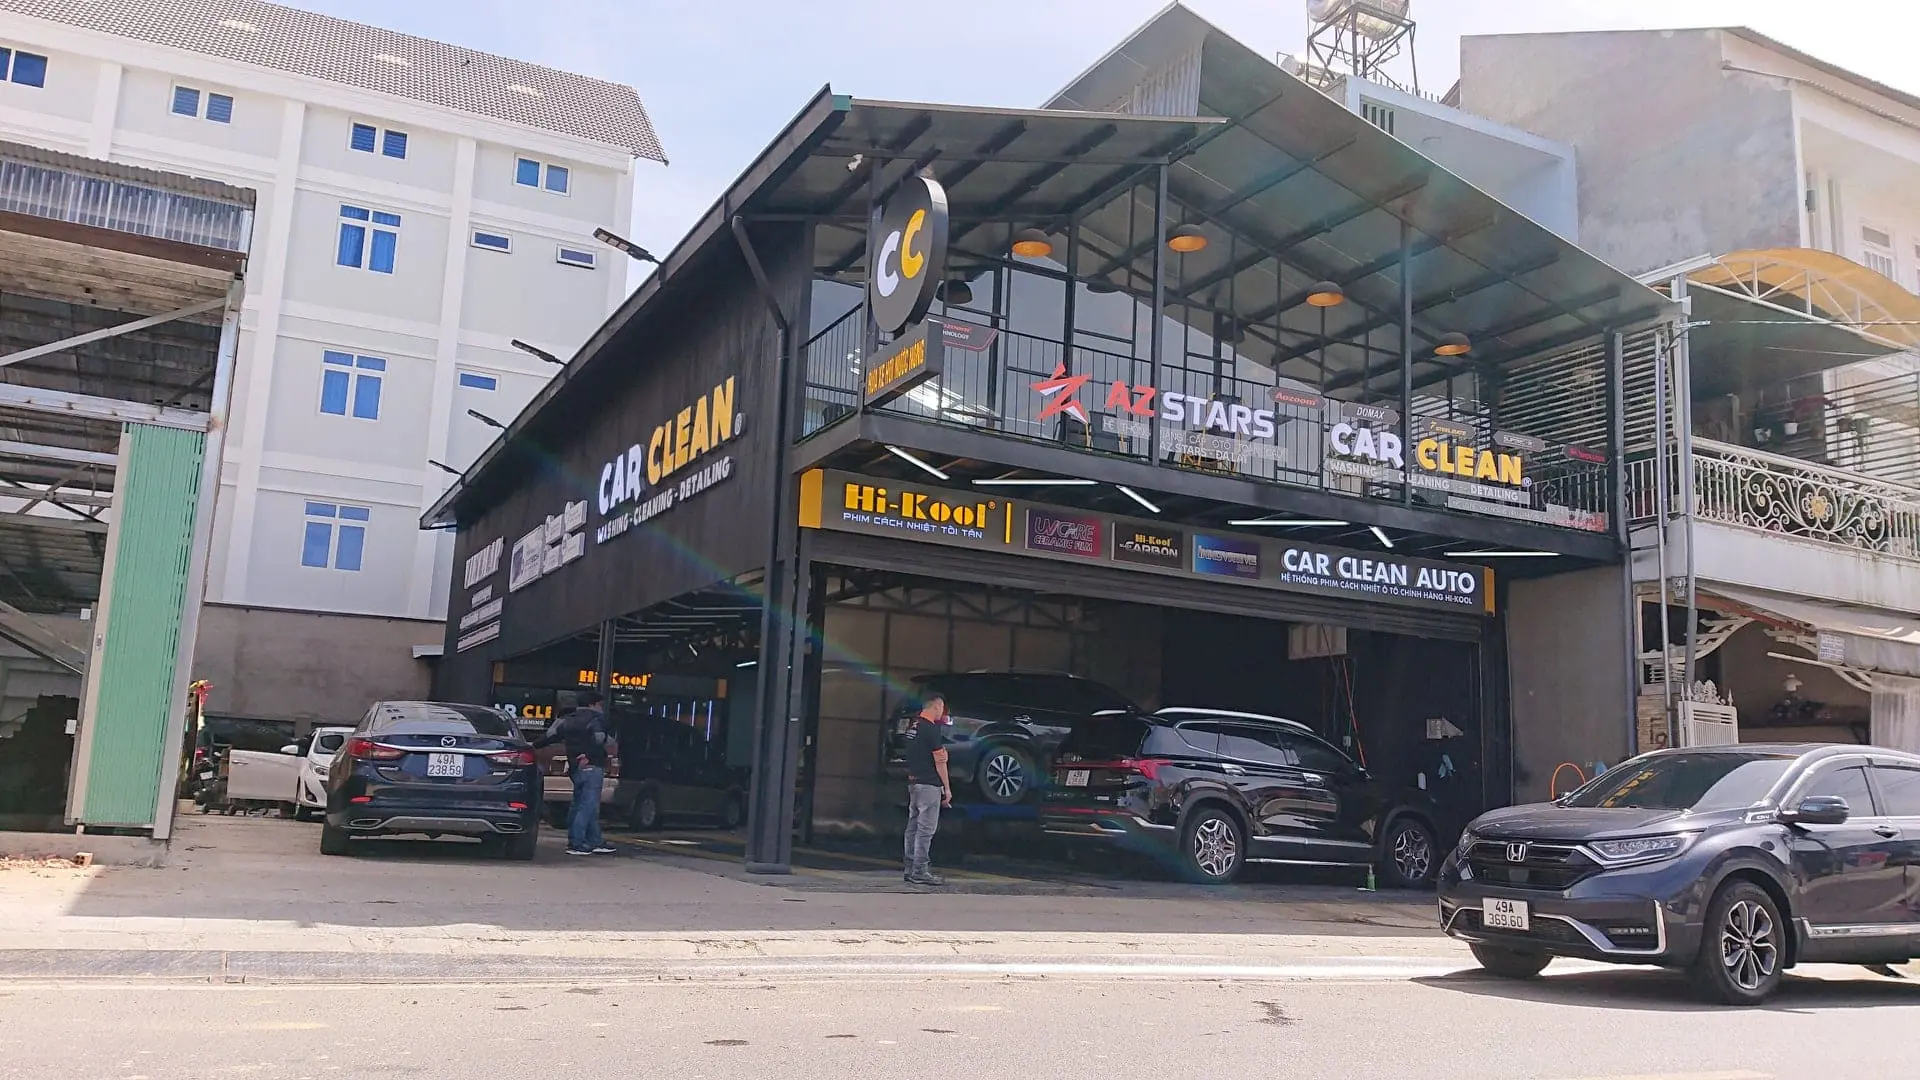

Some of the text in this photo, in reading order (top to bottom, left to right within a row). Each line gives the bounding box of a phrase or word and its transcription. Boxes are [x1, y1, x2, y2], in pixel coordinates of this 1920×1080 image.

[1104, 380, 1275, 438] AZ STARS
[1356, 406, 1385, 420] DOMAX
[598, 375, 735, 515] CAR CLEAN
[1175, 443, 1207, 458] STARS
[1330, 422, 1404, 468] CAR
[1417, 438, 1521, 485] CLEAN
[1330, 460, 1520, 502] WASHING CLEANING DETAILING
[597, 456, 730, 544] WASHING CLEANING DETAILING
[845, 483, 986, 529] Hi-Kool
[843, 512, 870, 523] PHIM
[873, 515, 903, 527] CÁCH
[906, 520, 938, 533] NHIỆT
[1034, 516, 1095, 542] UVCARE
[1033, 534, 1093, 552] CERAMIC FILM
[1125, 541, 1178, 558] CARBON
[1135, 533, 1172, 547] Hi-Kool
[1283, 549, 1475, 594] CAR CLEAN AUTO
[1281, 572, 1291, 583] HỆ
[1320, 578, 1339, 587] PHIM
[1445, 594, 1473, 605] HI-KOOL
[429, 765, 462, 776] 238.59
[436, 755, 455, 765] 49A
[1495, 901, 1514, 914] 49A
[1488, 913, 1523, 928] 369.60
